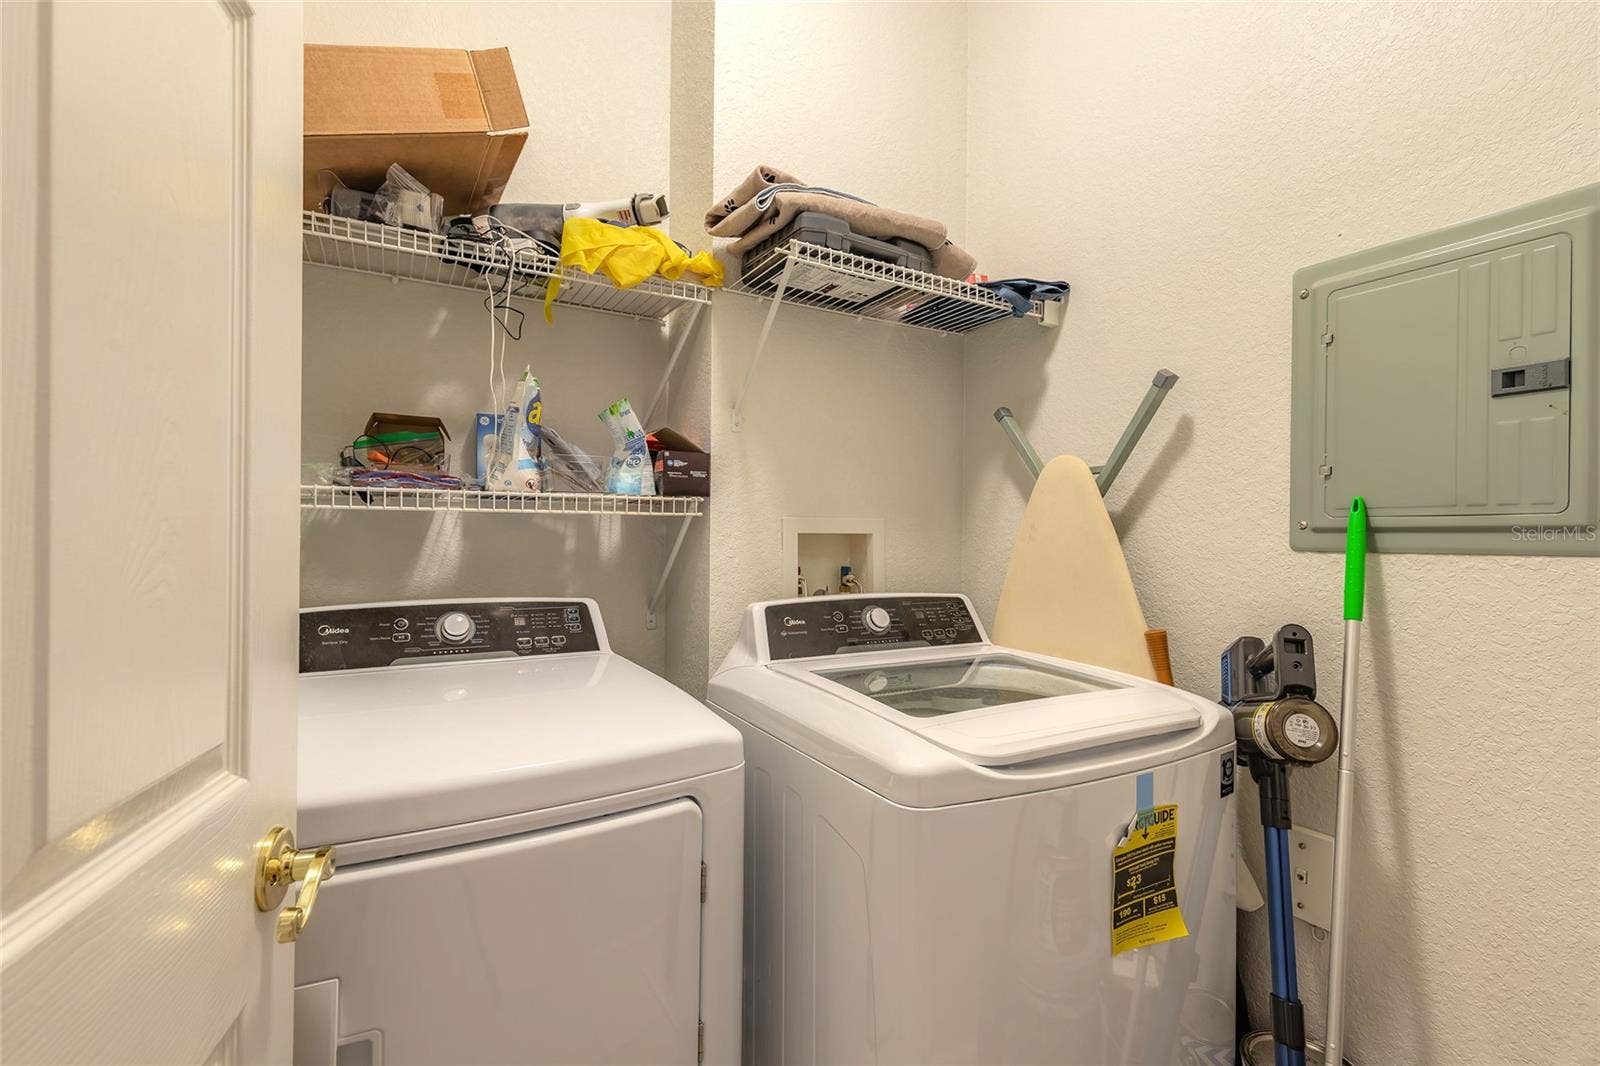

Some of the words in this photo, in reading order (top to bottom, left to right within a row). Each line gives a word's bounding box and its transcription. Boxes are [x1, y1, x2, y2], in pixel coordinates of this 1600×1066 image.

[783, 616, 806, 627] Midea
[317, 624, 350, 636] Midea
[1126, 874, 1142, 887] $23
[1153, 893, 1167, 905] $15
[1119, 907, 1132, 919] 190
